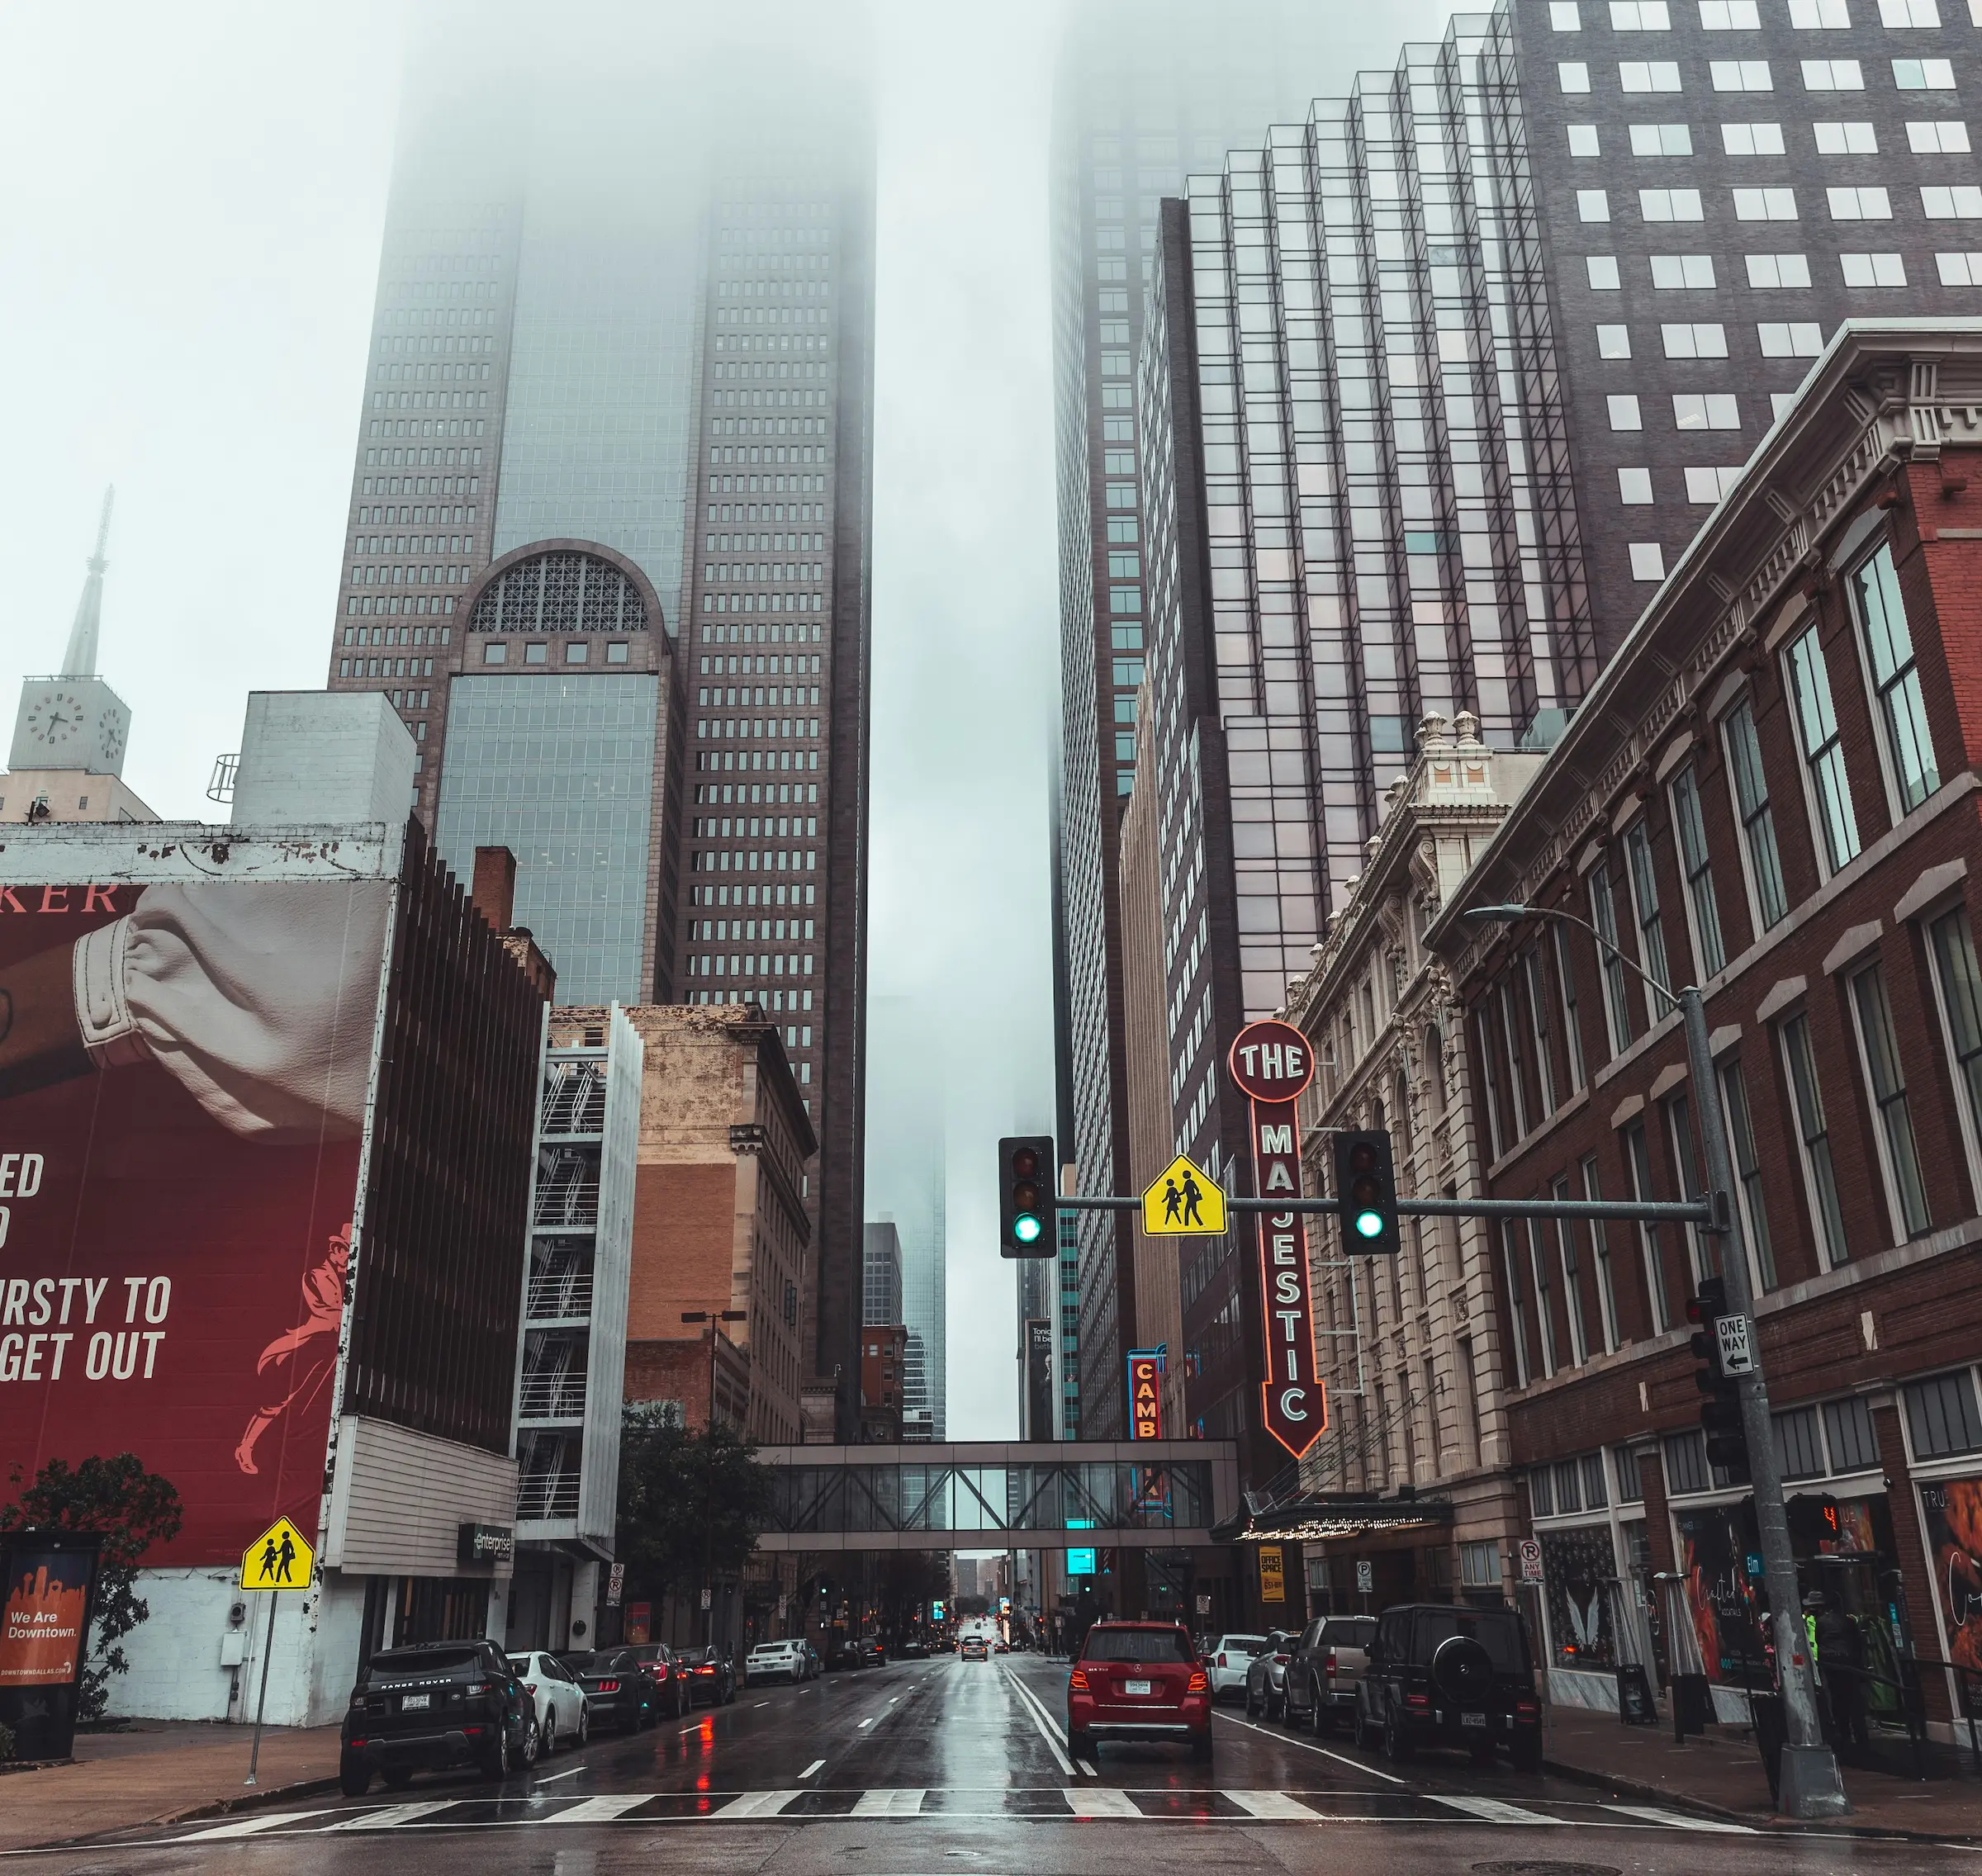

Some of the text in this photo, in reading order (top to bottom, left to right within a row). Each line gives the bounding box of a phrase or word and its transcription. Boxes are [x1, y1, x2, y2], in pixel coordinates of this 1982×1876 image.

[1240, 1043, 1304, 1080] THE
[1260, 1125, 1307, 1421] MAJESTIC
[0, 1277, 109, 1325] RSTY
[124, 1276, 172, 1324] TO
[1719, 1319, 1744, 1335] ONE
[1721, 1334, 1746, 1352] WAY
[0, 1330, 165, 1381] GET OUT
[1923, 1489, 1950, 1508] TRUE
[1823, 1505, 1837, 1531] 4
[474, 1533, 510, 1556] enterprise
[1261, 1556, 1281, 1564] OFFICE
[1262, 1564, 1282, 1573] SPACE
[1747, 1556, 1759, 1573] Elm
[11, 1611, 58, 1623] We Are
[8, 1627, 77, 1639] Downtown.
